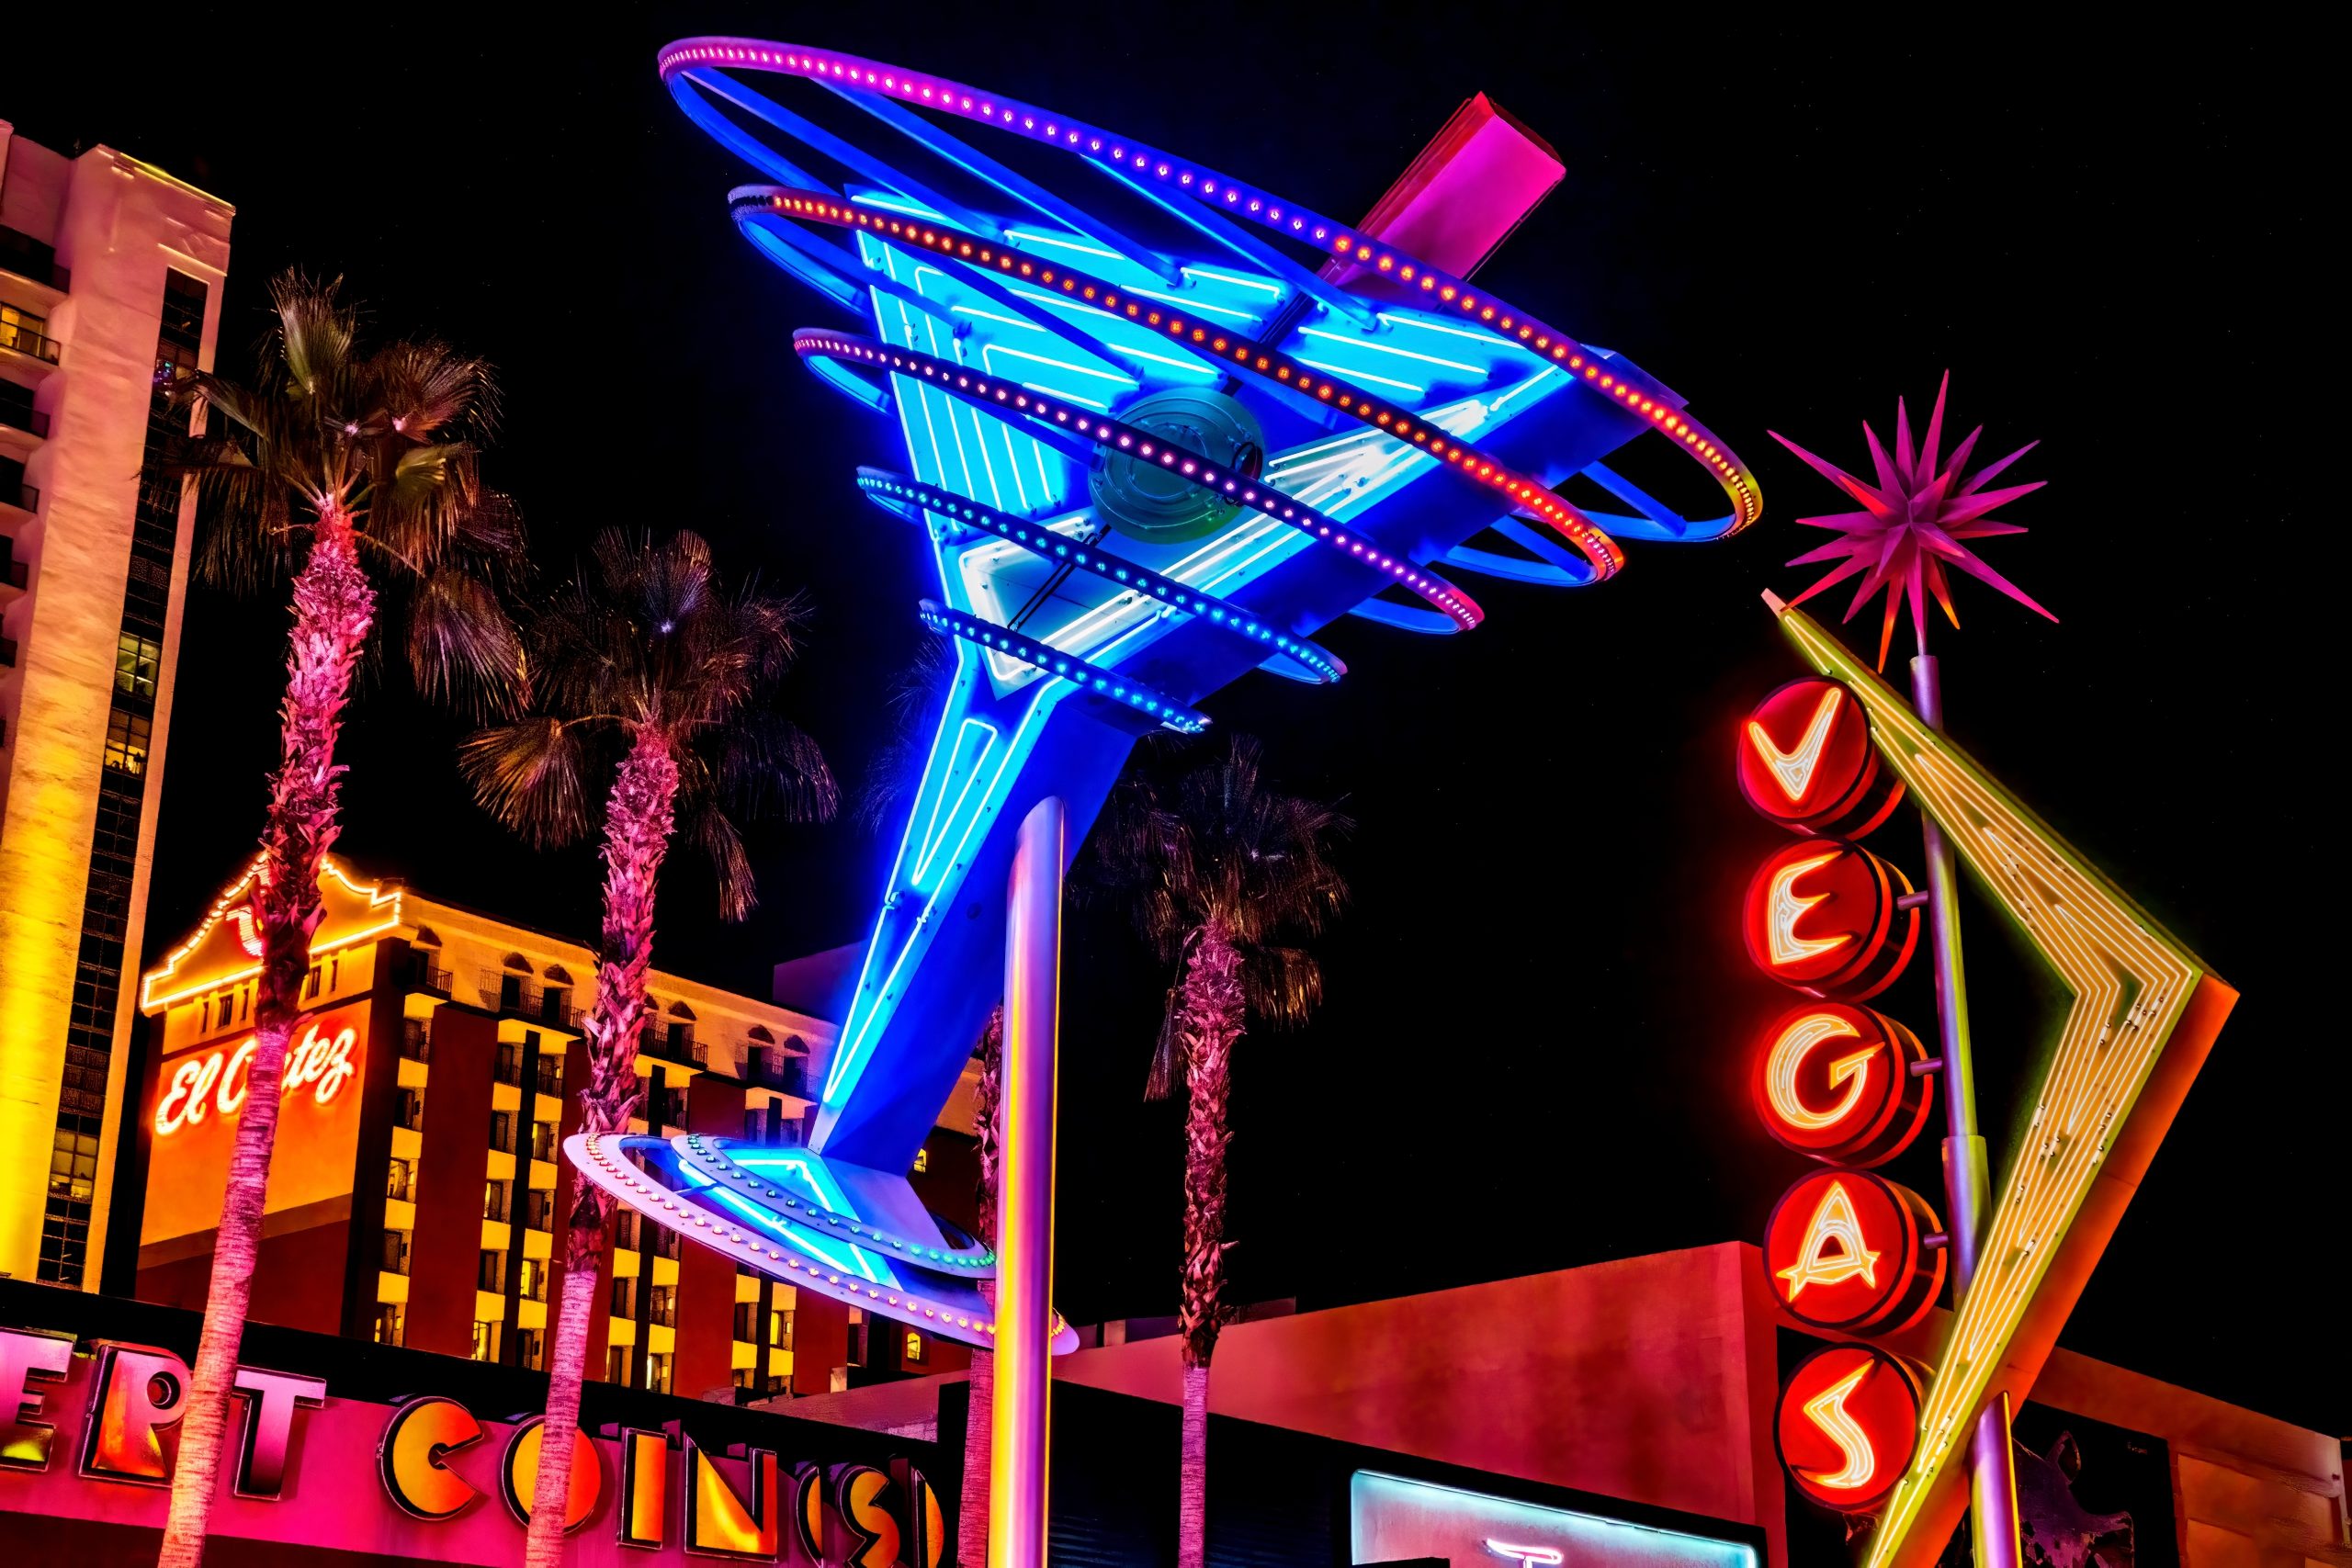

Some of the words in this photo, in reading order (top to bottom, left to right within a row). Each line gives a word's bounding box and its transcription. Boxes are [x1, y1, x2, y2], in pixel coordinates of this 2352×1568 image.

[154, 1052, 224, 1135] El
[216, 1022, 356, 1114] Ctez
[1747, 686, 1886, 1489] VEGAS
